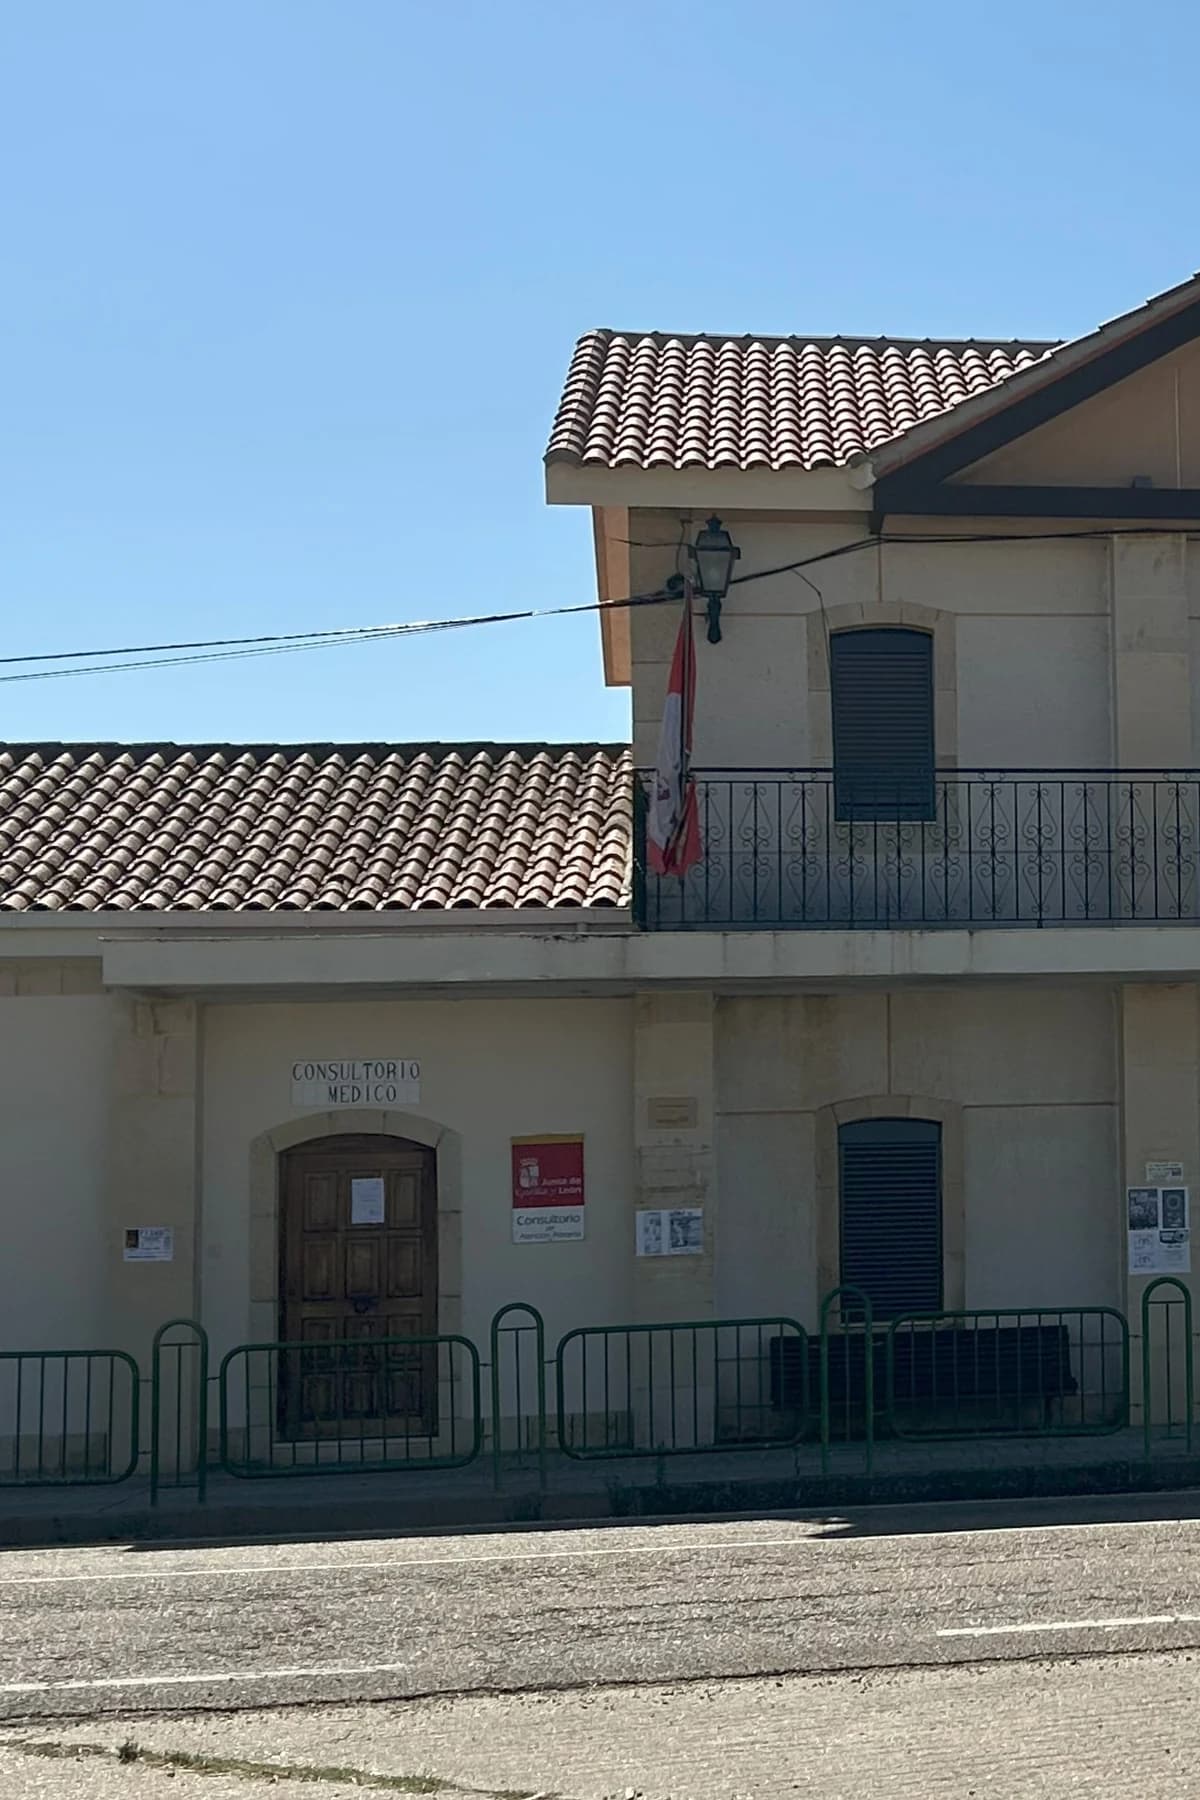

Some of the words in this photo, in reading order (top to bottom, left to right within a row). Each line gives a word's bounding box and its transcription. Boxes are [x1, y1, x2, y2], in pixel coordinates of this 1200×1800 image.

[292, 1062, 420, 1081] CONSULTORIO
[328, 1084, 397, 1104] MEDICO
[517, 1215, 581, 1226] Consultorio
